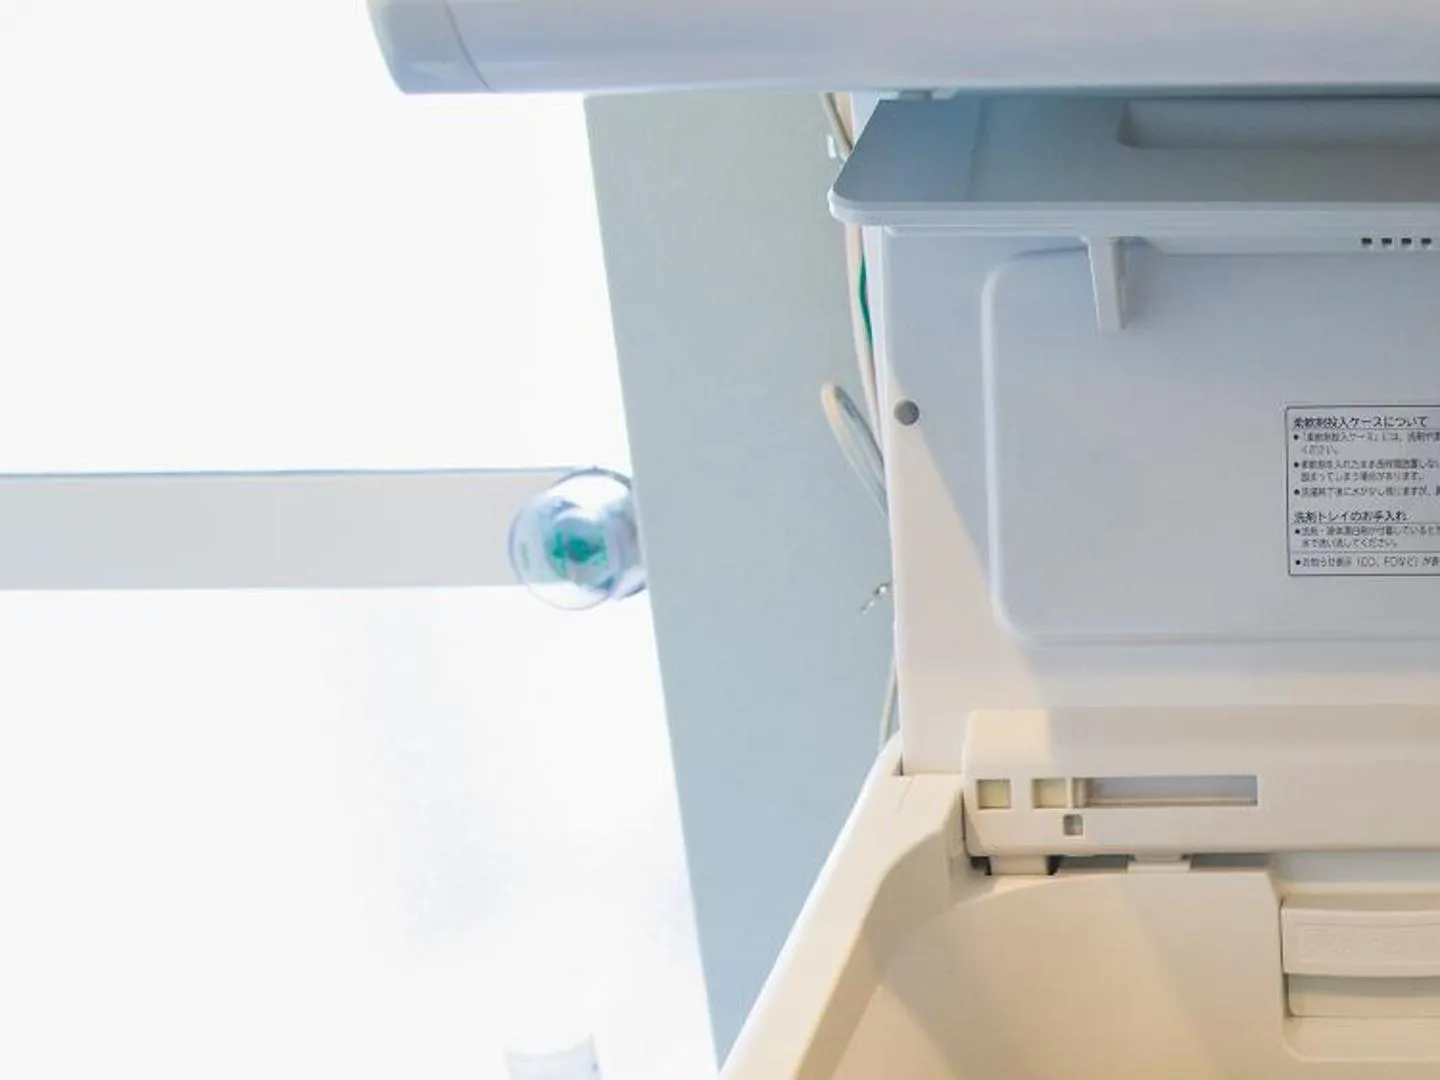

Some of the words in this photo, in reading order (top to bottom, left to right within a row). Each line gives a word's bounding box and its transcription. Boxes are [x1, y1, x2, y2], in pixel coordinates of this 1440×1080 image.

[1293, 509, 1411, 524] 洗剤トレイのお手入れ
